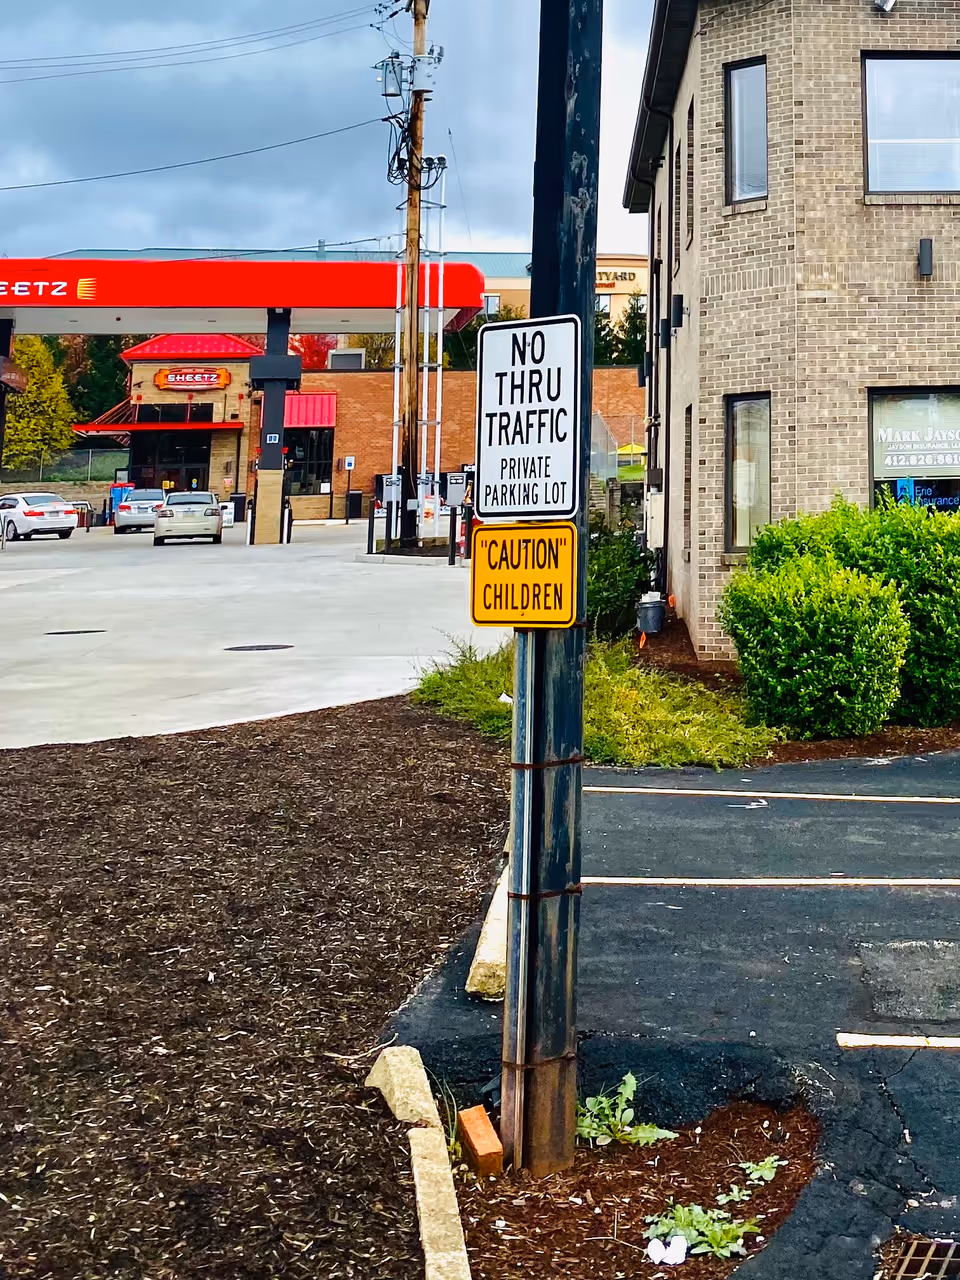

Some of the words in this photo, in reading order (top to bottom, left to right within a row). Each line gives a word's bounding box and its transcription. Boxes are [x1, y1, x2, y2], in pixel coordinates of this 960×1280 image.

[595, 271, 637, 282] TYARD
[511, 330, 546, 367] NO
[167, 373, 218, 382] SHEETZ
[495, 367, 562, 406] THRU
[485, 407, 568, 446] TRAFFIC
[878, 427, 920, 442] MARK
[500, 456, 552, 480] PRIVATE
[485, 482, 539, 508] PARKING
[544, 481, 568, 505] LOT
[915, 485, 933, 496] Erie
[916, 496, 960, 506] nsurance
[481, 536, 568, 571] "CAUTION"
[483, 582, 563, 611] CHILDREN
